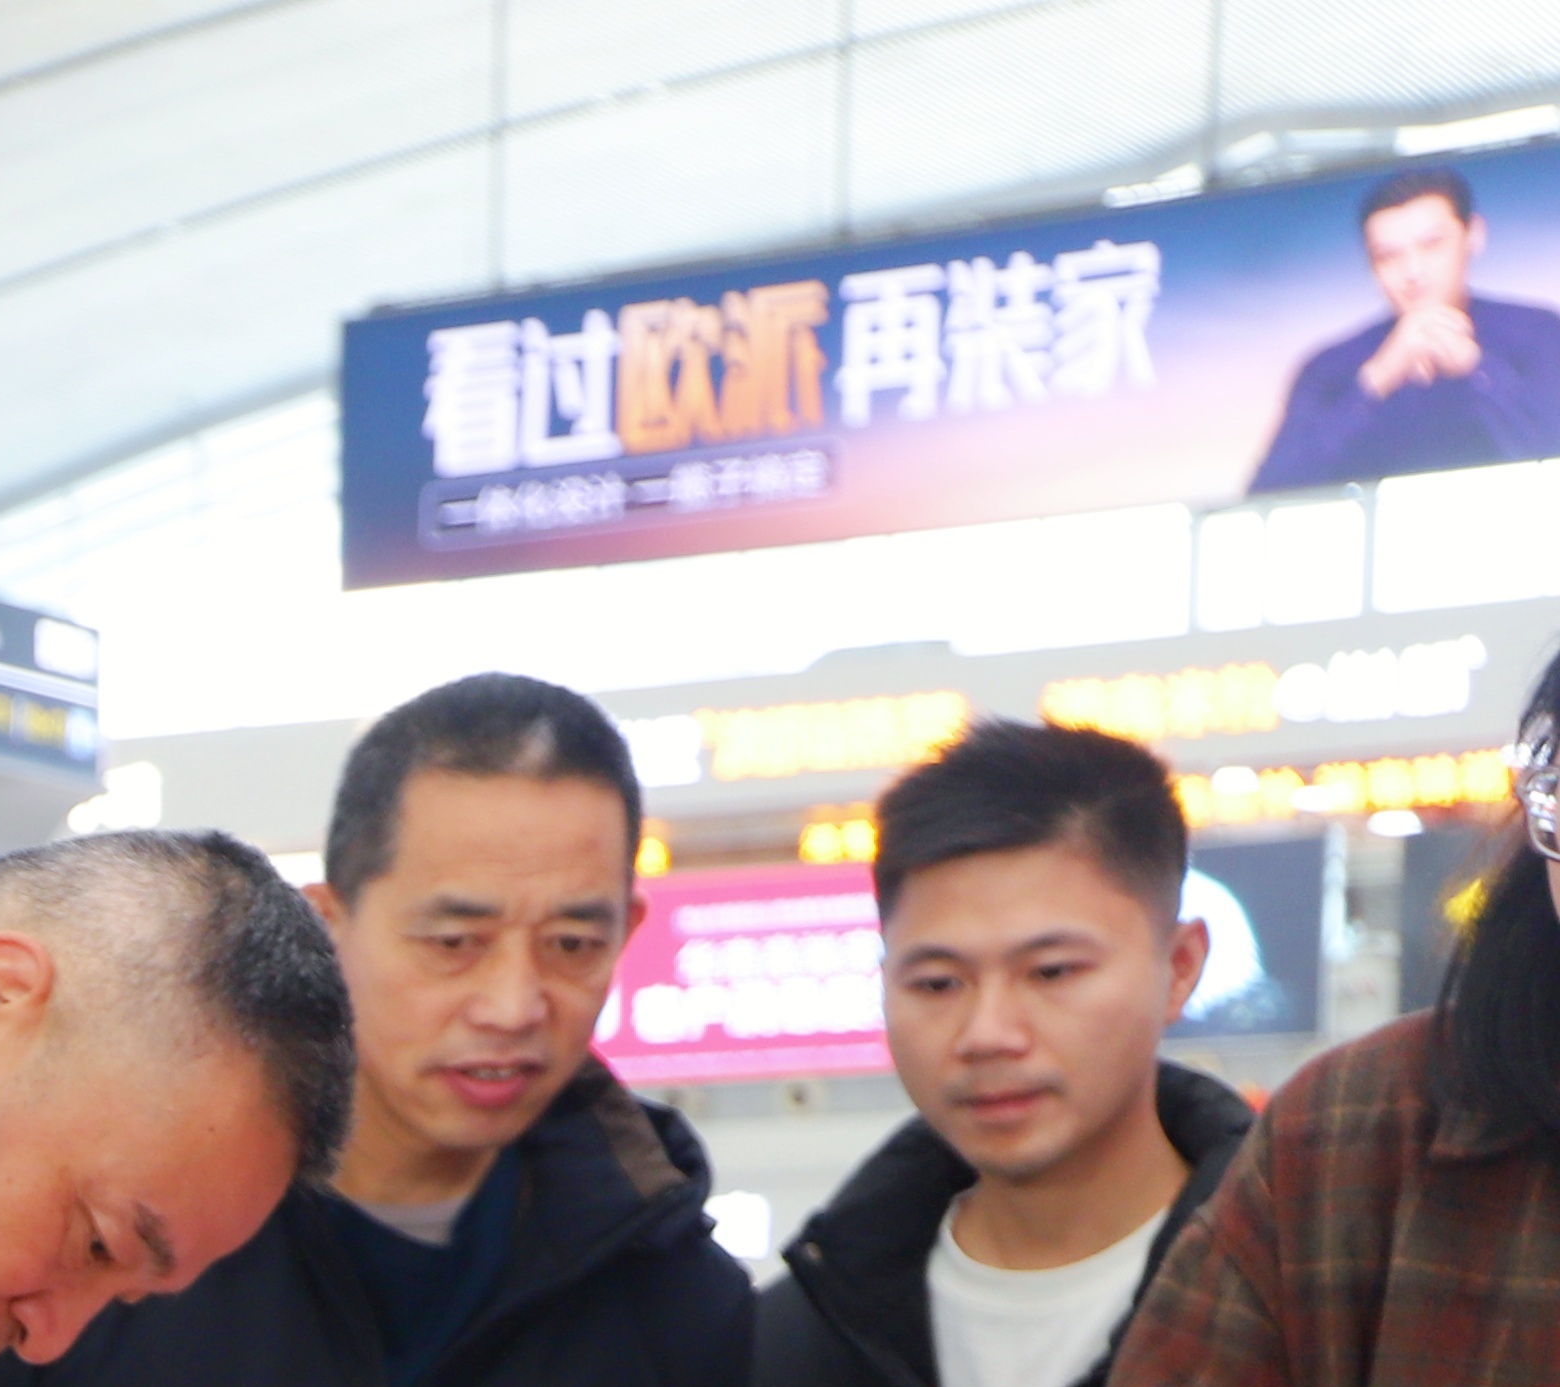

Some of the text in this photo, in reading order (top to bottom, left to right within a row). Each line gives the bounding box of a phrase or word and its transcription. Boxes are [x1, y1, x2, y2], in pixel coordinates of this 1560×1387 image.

[422, 241, 1163, 479] 看过欧派 再装家
